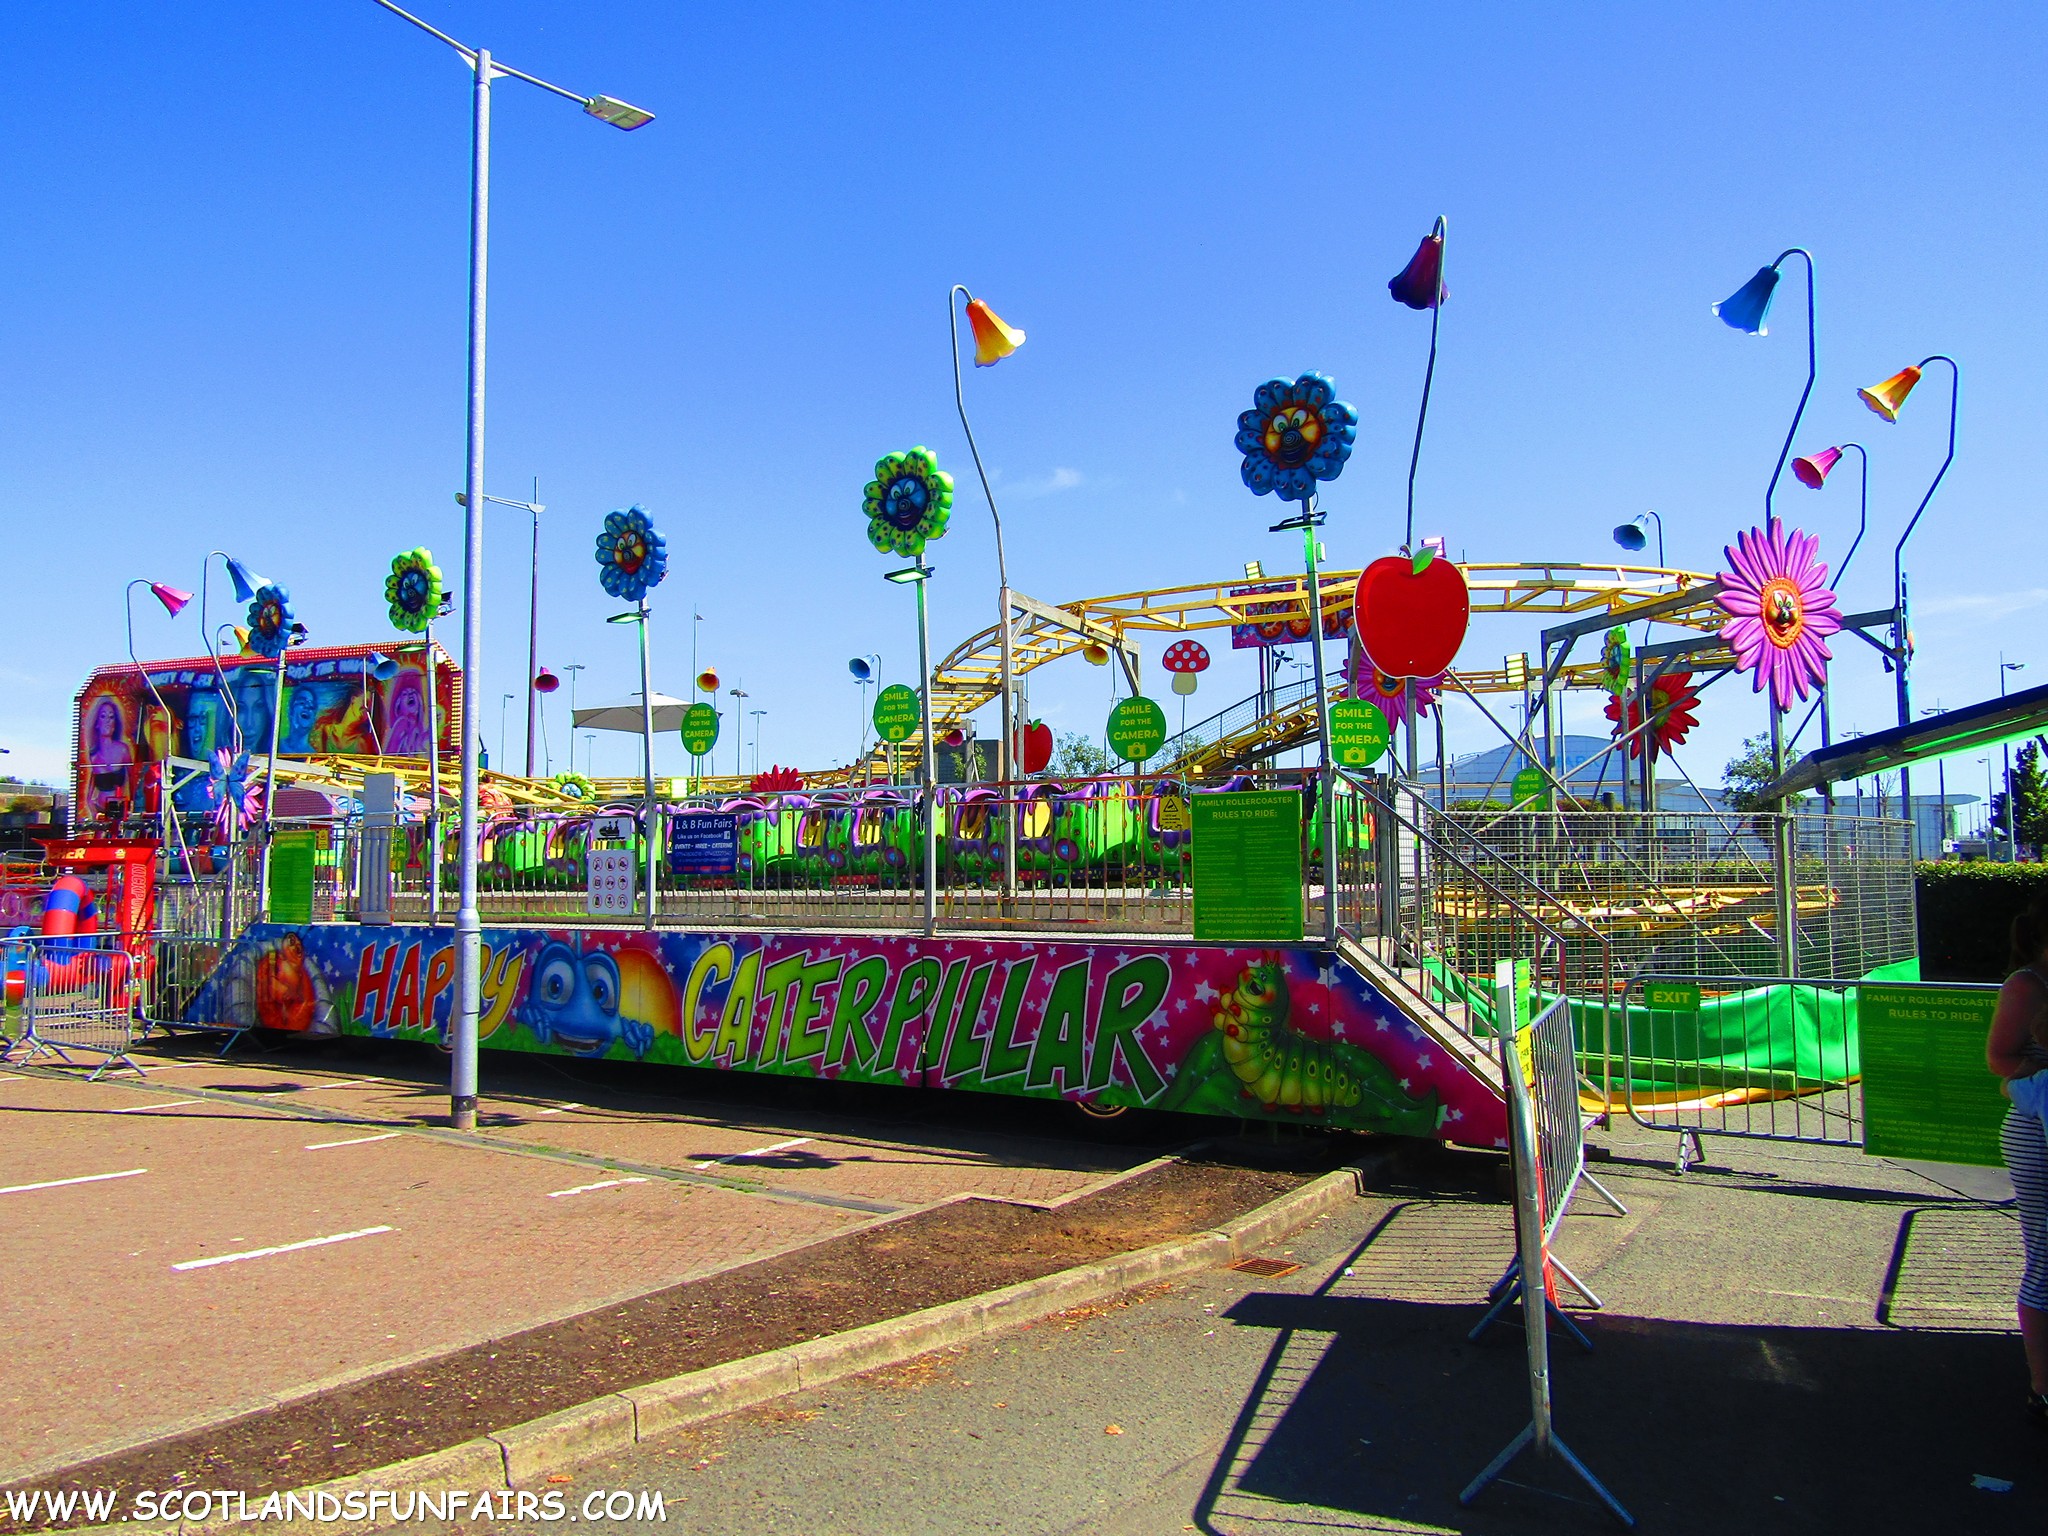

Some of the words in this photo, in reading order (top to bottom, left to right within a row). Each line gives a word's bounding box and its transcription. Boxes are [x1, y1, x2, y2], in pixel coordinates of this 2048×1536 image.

[884, 692, 909, 701] SMILE
[690, 709, 711, 718] SMILE
[1120, 704, 1152, 715] SMILE
[1336, 708, 1372, 718] SMILE
[878, 714, 914, 724] CAMERA
[684, 730, 714, 738] CAMERA
[1114, 730, 1159, 740] CAMERA
[1197, 800, 1224, 808] FAMILY
[1226, 796, 1292, 806] ROLLERCOASTER
[1212, 810, 1240, 819] RULES
[1241, 810, 1252, 818] TO
[1254, 809, 1278, 818] RIDE:
[676, 820, 680, 830] L
[682, 820, 688, 830] &
[690, 820, 696, 829] B
[698, 819, 712, 829] Fun
[714, 818, 733, 828] Fairs
[1652, 991, 1690, 1004] EXIT
[1866, 994, 1906, 1003] FAMILY
[1908, 996, 1997, 1007] ROLLERCOASTE
[1888, 1008, 1927, 1019] RULES
[1930, 1011, 1946, 1020] TO
[1950, 1012, 1984, 1022] RIDE:
[352, 939, 527, 1041] HAPY
[682, 941, 1172, 1103] CATERPILLAR
